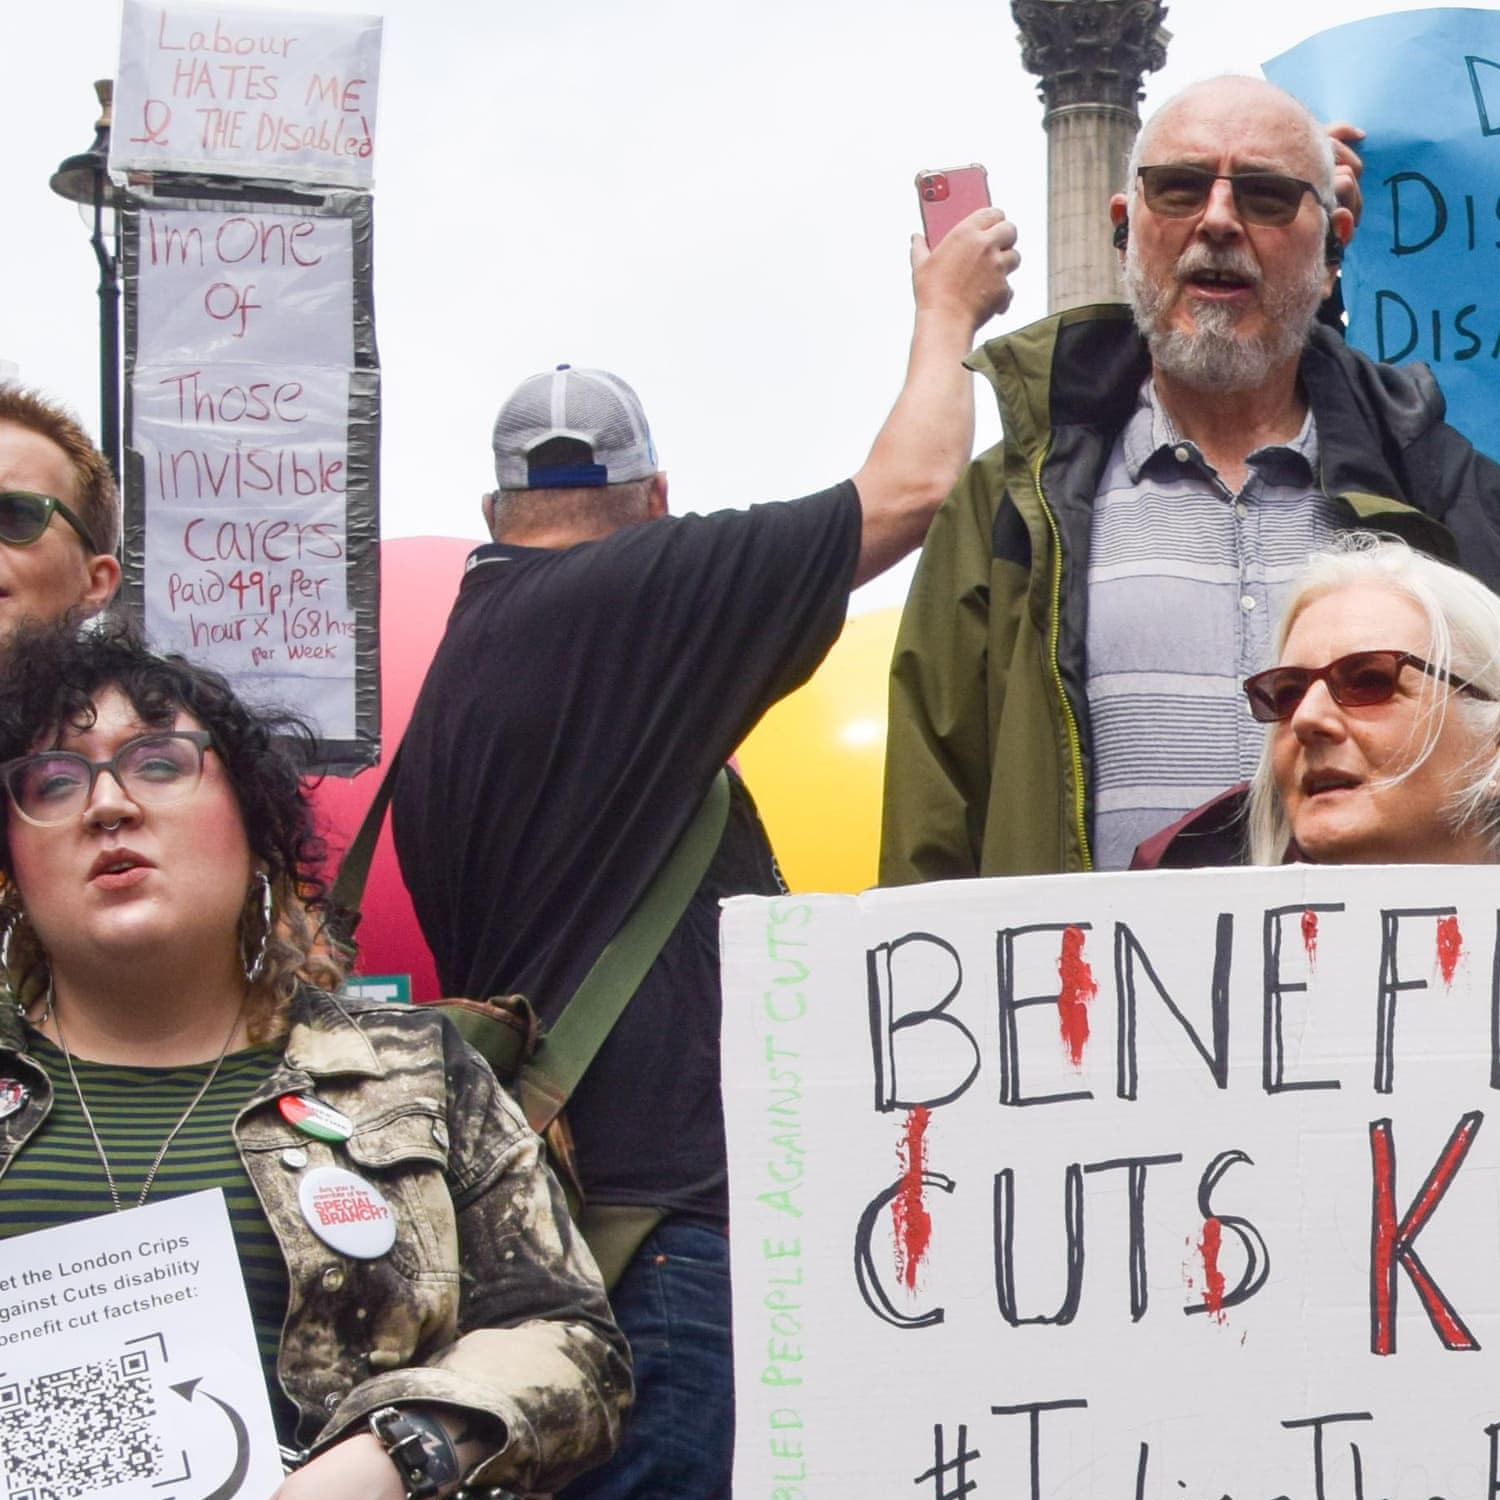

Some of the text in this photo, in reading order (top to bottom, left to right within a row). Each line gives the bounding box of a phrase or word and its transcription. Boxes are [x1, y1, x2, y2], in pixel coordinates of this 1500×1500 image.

[158, 9, 299, 58] Labour
[172, 57, 367, 113] HATES ME
[196, 107, 250, 150] THE
[215, 216, 323, 267] One
[204, 282, 263, 338] Of
[158, 370, 308, 425] Those
[227, 569, 281, 615] 49p
[189, 613, 247, 647] hour
[281, 608, 323, 643] 168
[313, 1197, 377, 1214] SPECIAL
[319, 1206, 389, 1226] BRANCH?
[22, 1269, 53, 1287] the
[58, 1251, 133, 1278] London
[138, 1235, 190, 1257] Crips
[854, 1148, 1270, 1330] CUTS
[63, 1283, 108, 1304] Cuts
[114, 1260, 200, 1291] disability
[68, 1310, 99, 1330] cut
[104, 1285, 199, 1320] factsheet:
[760, 1235, 803, 1390] PEOPLE
